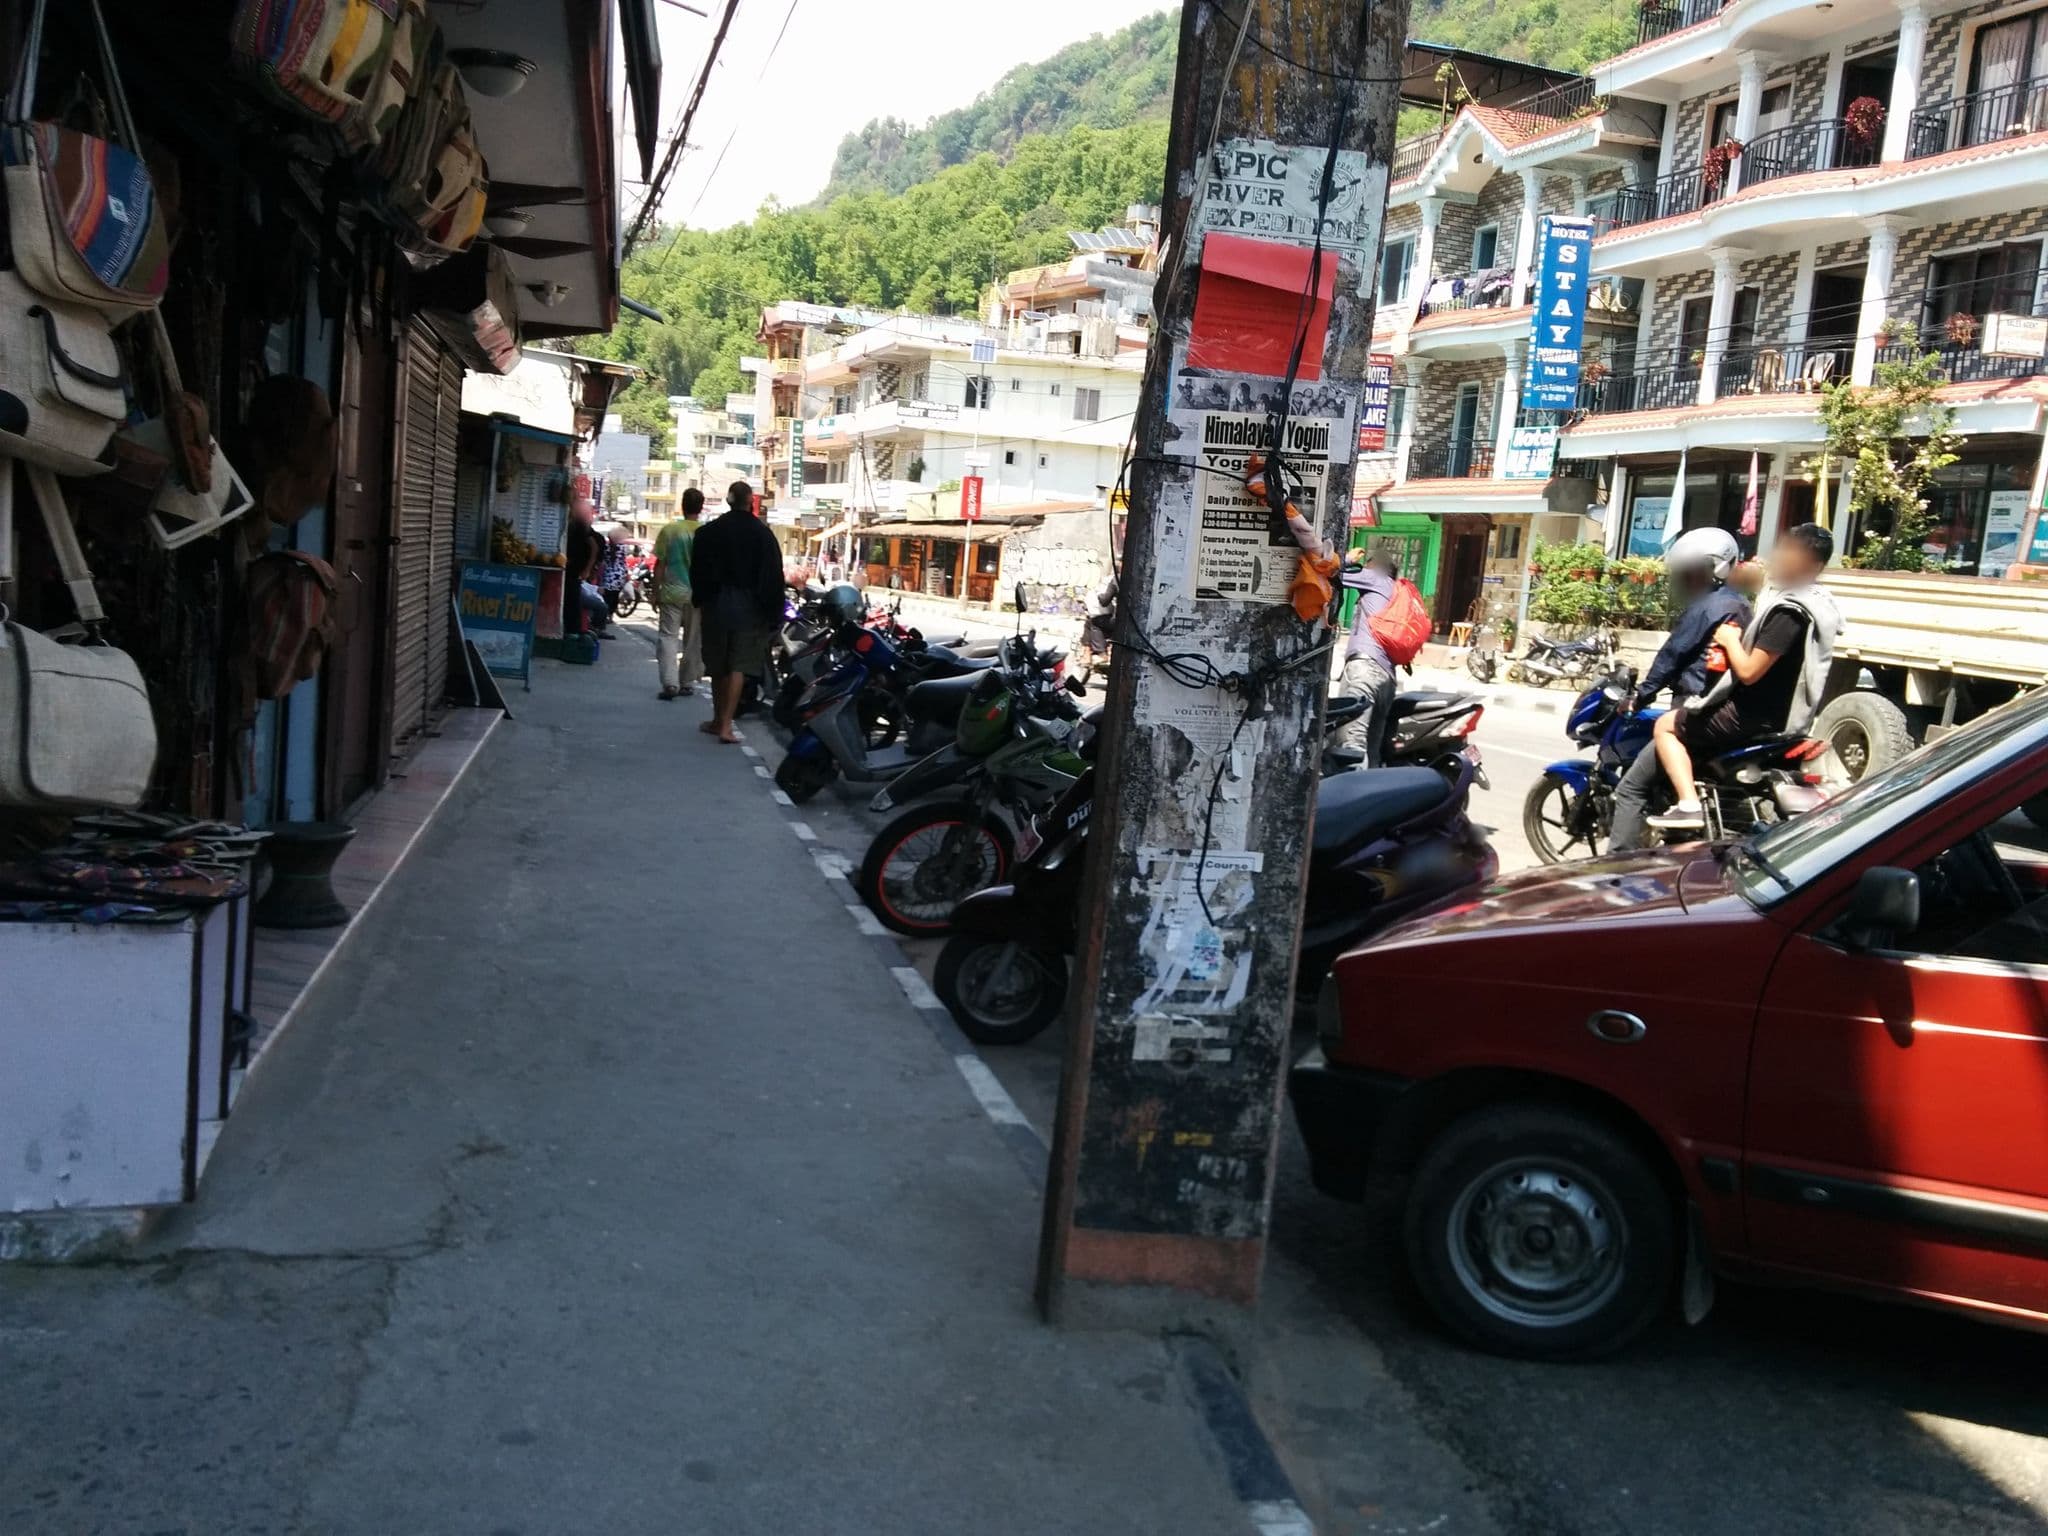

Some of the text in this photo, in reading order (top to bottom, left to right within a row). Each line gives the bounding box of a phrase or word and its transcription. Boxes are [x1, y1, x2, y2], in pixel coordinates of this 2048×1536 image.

[1207, 182, 1285, 207] RIVER
[1204, 207, 1370, 241] EXPEDITIONS
[1551, 227, 1590, 240] HOTEL
[1204, 415, 1282, 450] Himalaya
[1287, 420, 1331, 453] Yogini
[1286, 460, 1325, 476] ealing
[1207, 495, 1230, 506] Daily
[1203, 535, 1226, 544] Course
[1231, 537, 1259, 545] Program
[1212, 548, 1223, 557] day
[1224, 548, 1249, 558] Package
[463, 588, 534, 624] River Fun
[1204, 860, 1249, 870] Course
